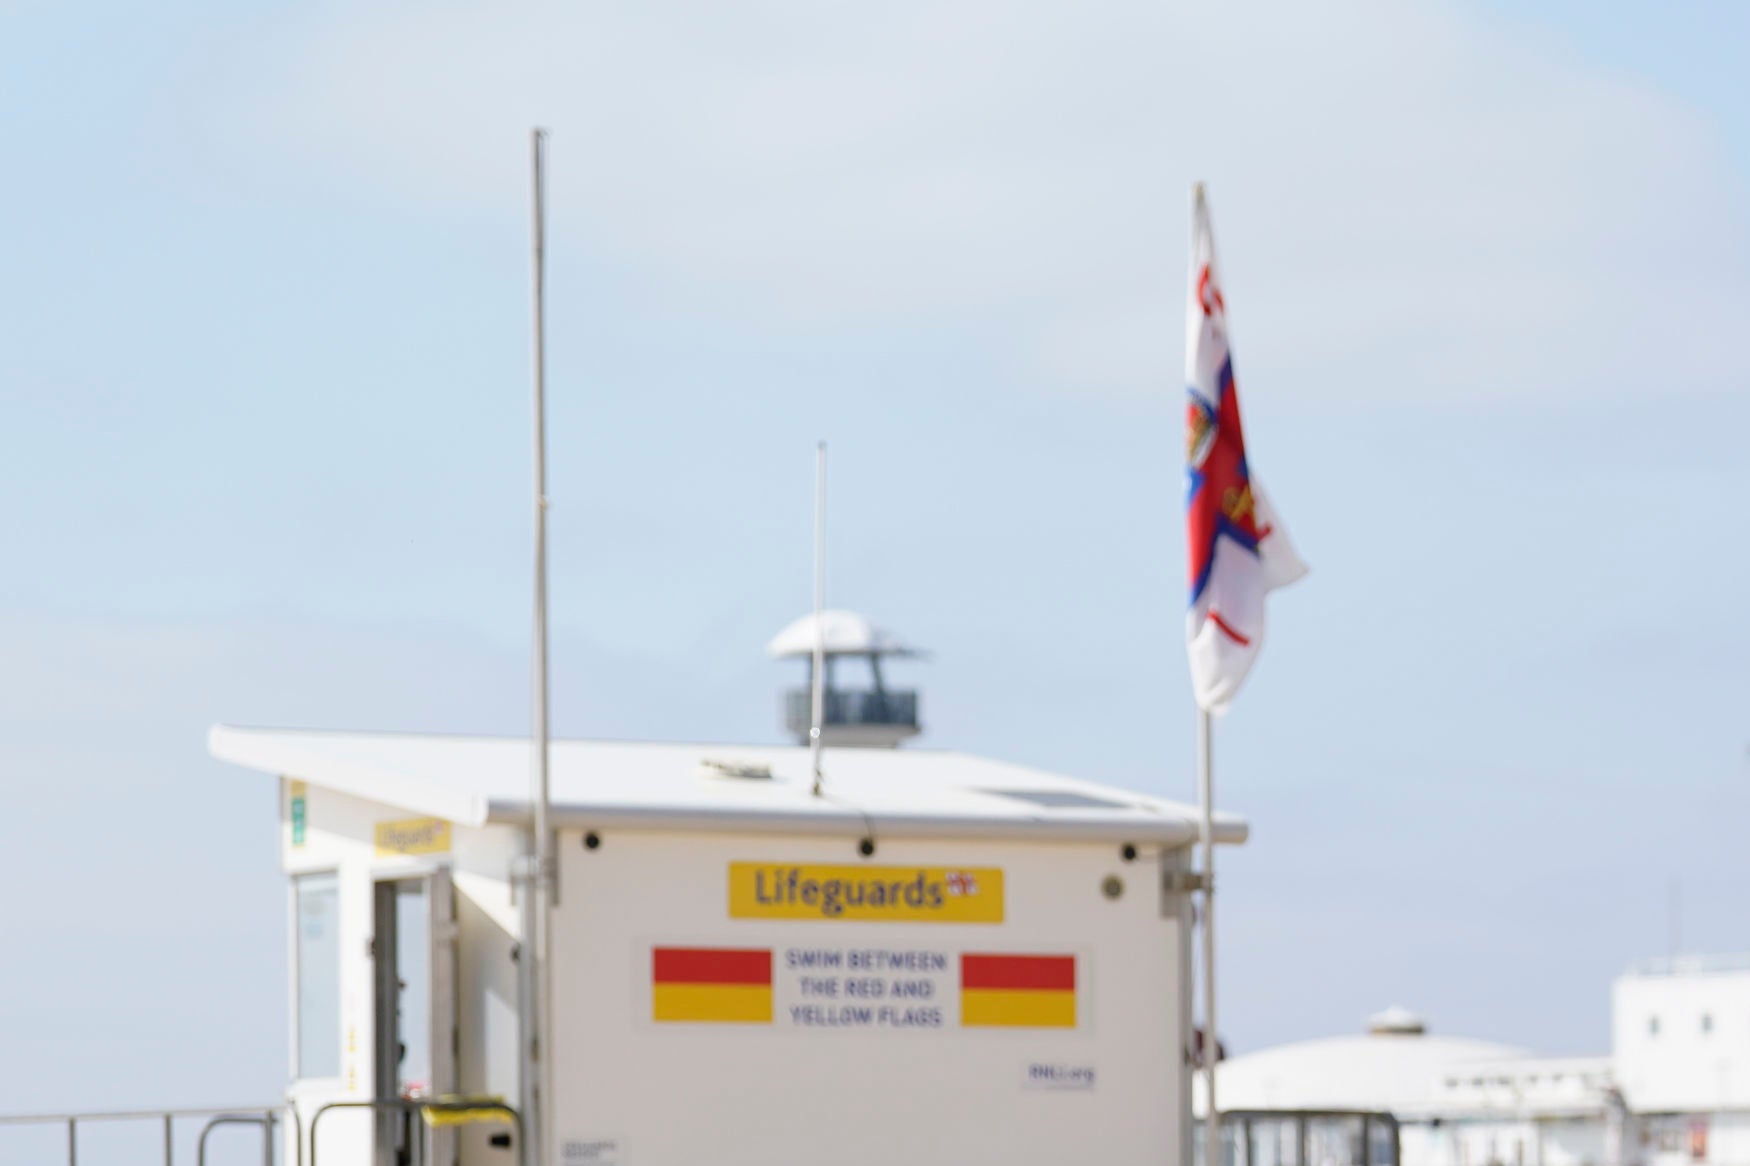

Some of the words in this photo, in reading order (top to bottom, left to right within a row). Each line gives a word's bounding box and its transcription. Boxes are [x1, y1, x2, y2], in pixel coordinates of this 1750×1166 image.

[755, 868, 945, 917] Lifeguards
[785, 949, 842, 970] SWIM
[847, 950, 948, 971] BETWEEN
[799, 976, 839, 997] THE
[844, 977, 886, 998] RED
[890, 978, 935, 999] AND
[789, 1004, 872, 1027] YELLOW
[877, 1005, 944, 1028] FLAGS
